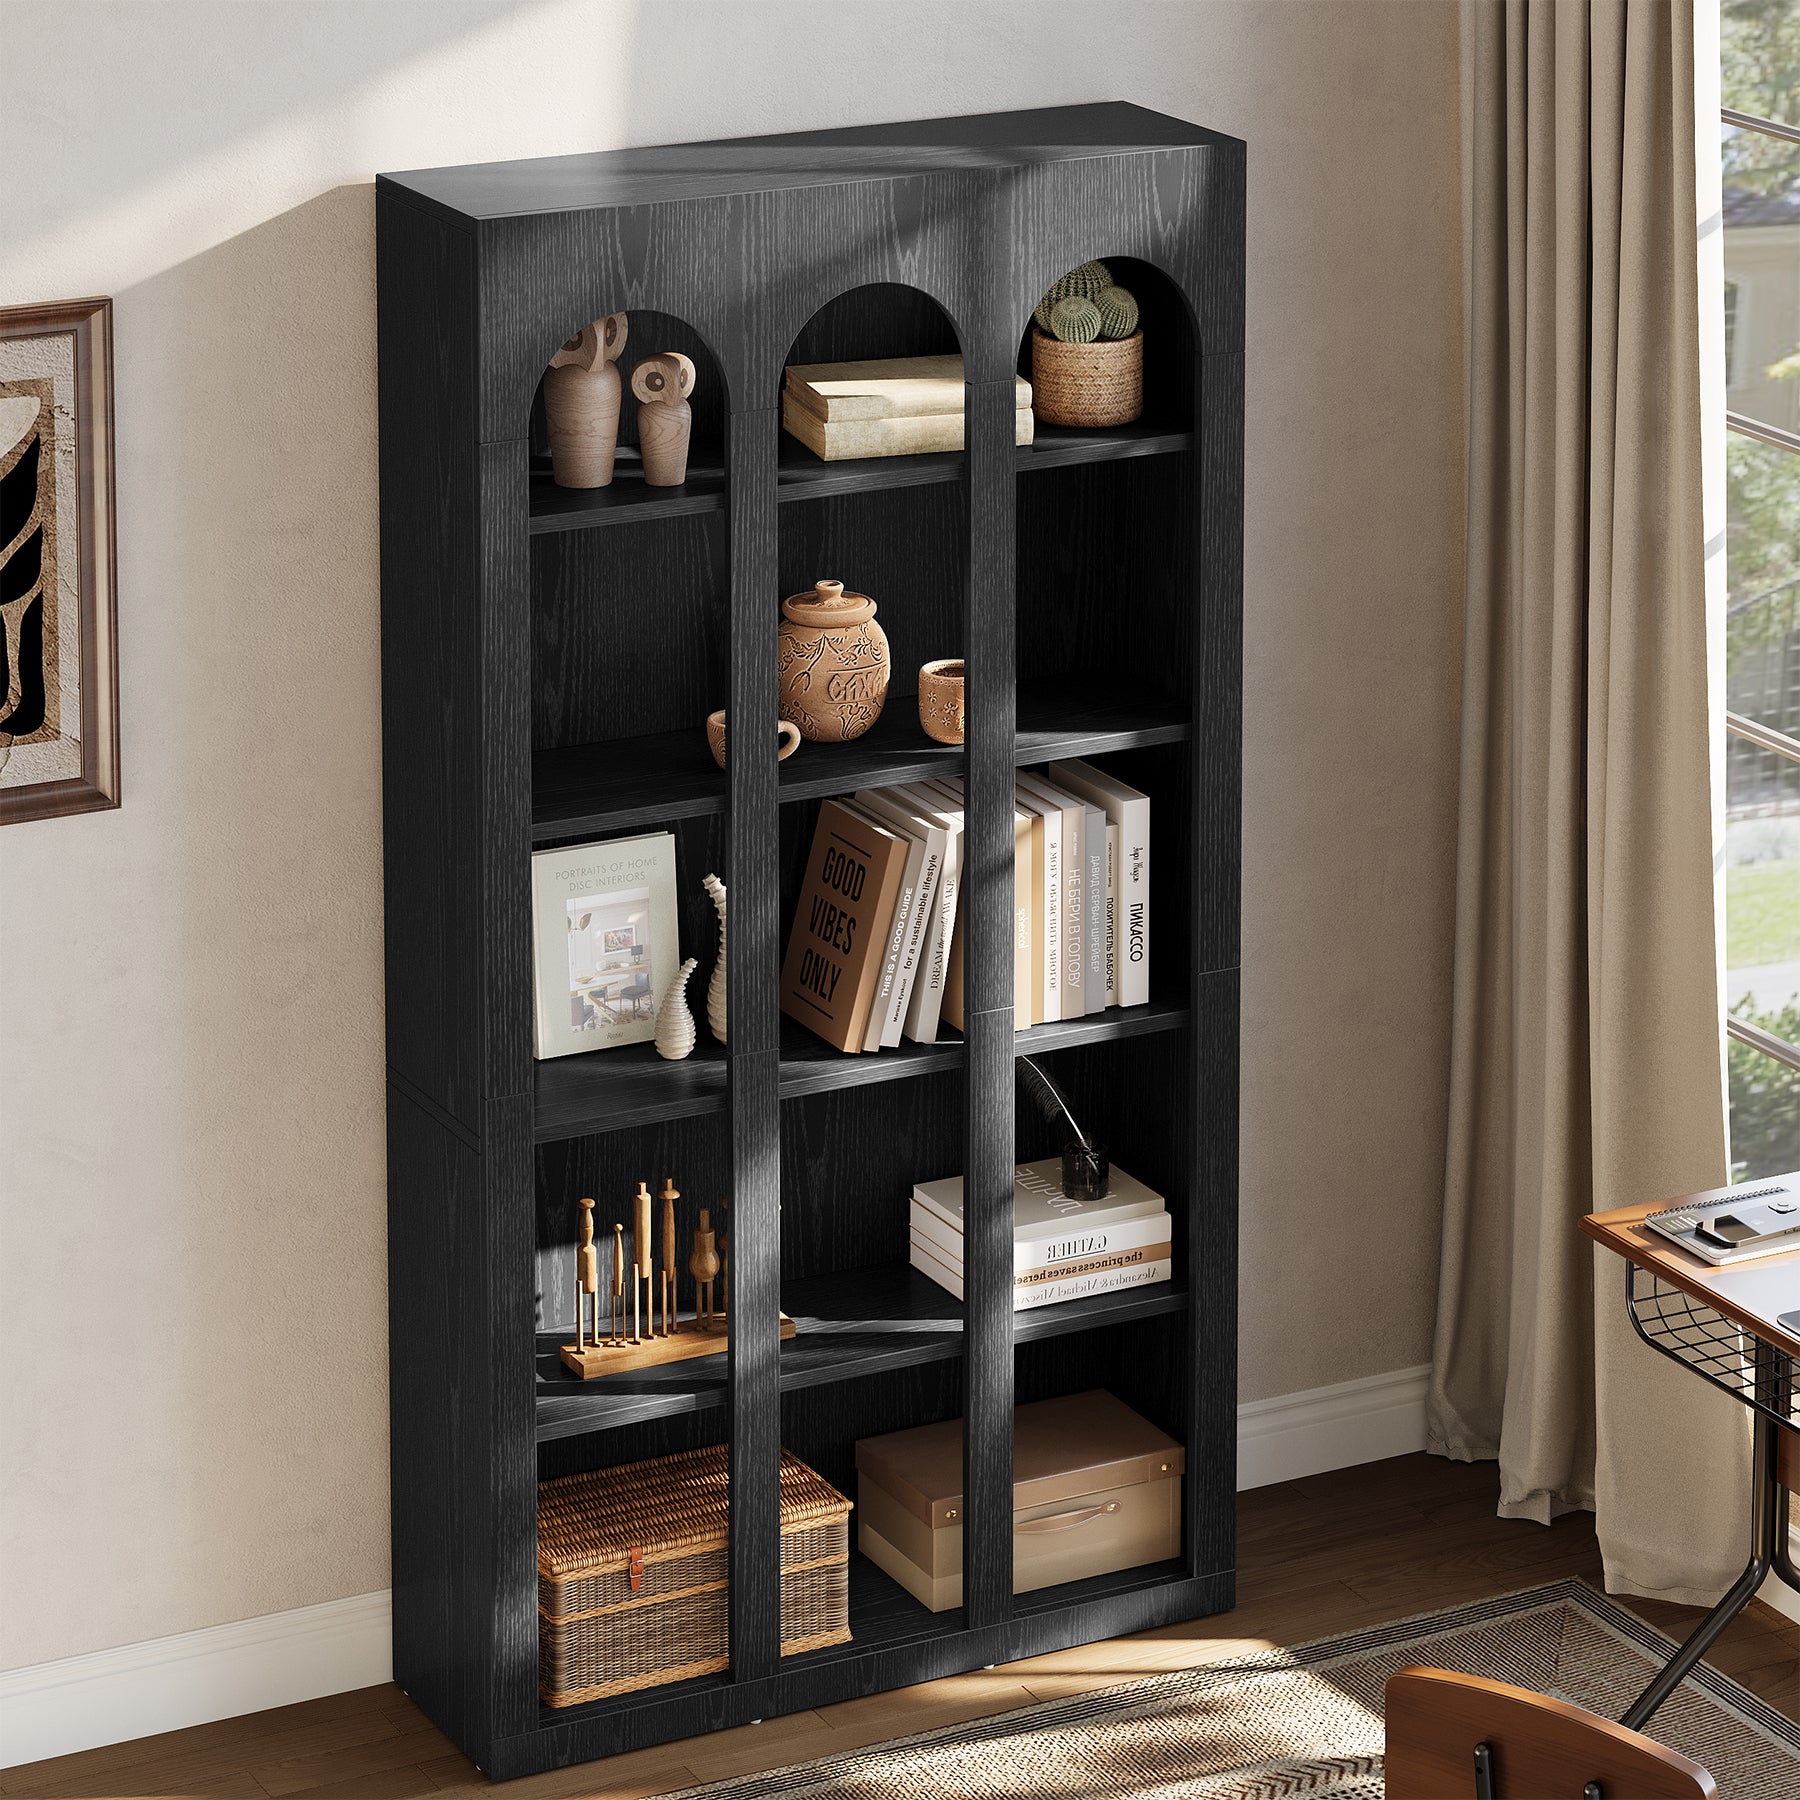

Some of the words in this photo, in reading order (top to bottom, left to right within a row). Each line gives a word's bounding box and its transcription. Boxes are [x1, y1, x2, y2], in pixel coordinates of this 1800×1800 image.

[555, 864, 607, 880] PORTRAITS
[610, 862, 624, 872] OF
[628, 856, 657, 869] HOME
[569, 880, 592, 892] DISC
[595, 871, 646, 887] INTERIORS
[822, 846, 866, 902] GOOD
[1069, 868, 1080, 886] НЕ
[1090, 855, 1100, 888] ДАВИД
[900, 887, 913, 920] GUIDE
[903, 957, 913, 970] for
[911, 893, 928, 946] sustainable
[922, 854, 938, 890] lifestyle
[1069, 889, 1080, 922] БЕРИ
[809, 894, 857, 955] VIBES
[892, 921, 905, 951] GOOD
[1016, 908, 1029, 949] spherical
[1069, 925, 1080, 934] В
[1090, 888, 1101, 973] СЕРВАН-ШРЕЙБЕР
[1106, 897, 1114, 952] ПОХИТИТЕЛЬ
[1130, 903, 1143, 962] ПИКАССО
[800, 948, 843, 1003] ONLY
[887, 963, 895, 974] IS
[890, 954, 898, 962] A
[930, 951, 944, 989] DREAM
[1049, 949, 1057, 991] МНОГОЕ
[1068, 937, 1080, 988] ГОЛОВУ
[1106, 953, 1114, 992] БАБОЧЕК
[881, 974, 892, 998] THIS
